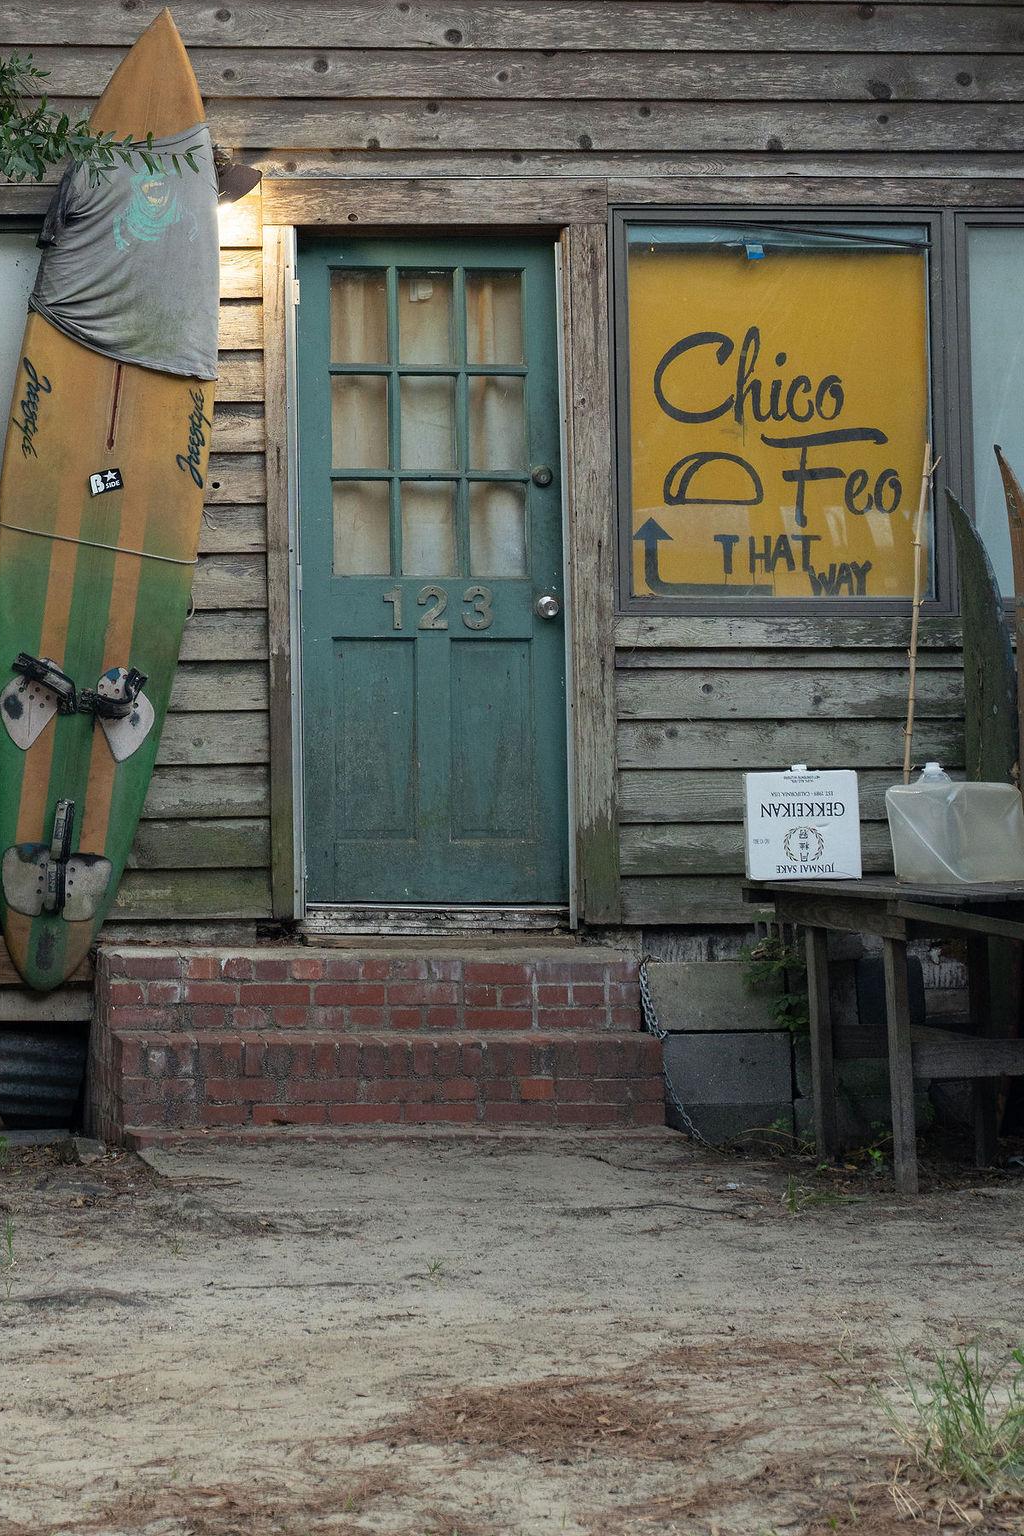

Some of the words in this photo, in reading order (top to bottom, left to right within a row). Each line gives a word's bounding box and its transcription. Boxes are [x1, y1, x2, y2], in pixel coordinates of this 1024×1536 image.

[653, 325, 845, 424] Chico
[13, 357, 52, 460] Freestyle
[176, 388, 212, 490] Freestyle
[90, 474, 105, 494] B
[105, 480, 120, 489] SIDE
[760, 427, 902, 528] Feo
[713, 534, 822, 573] THAT
[808, 560, 872, 596] WAY
[383, 584, 494, 631] 123
[760, 802, 845, 818] GEKKEIKAN
[776, 865, 797, 874] SAKE
[800, 862, 835, 874] JUNMAI
